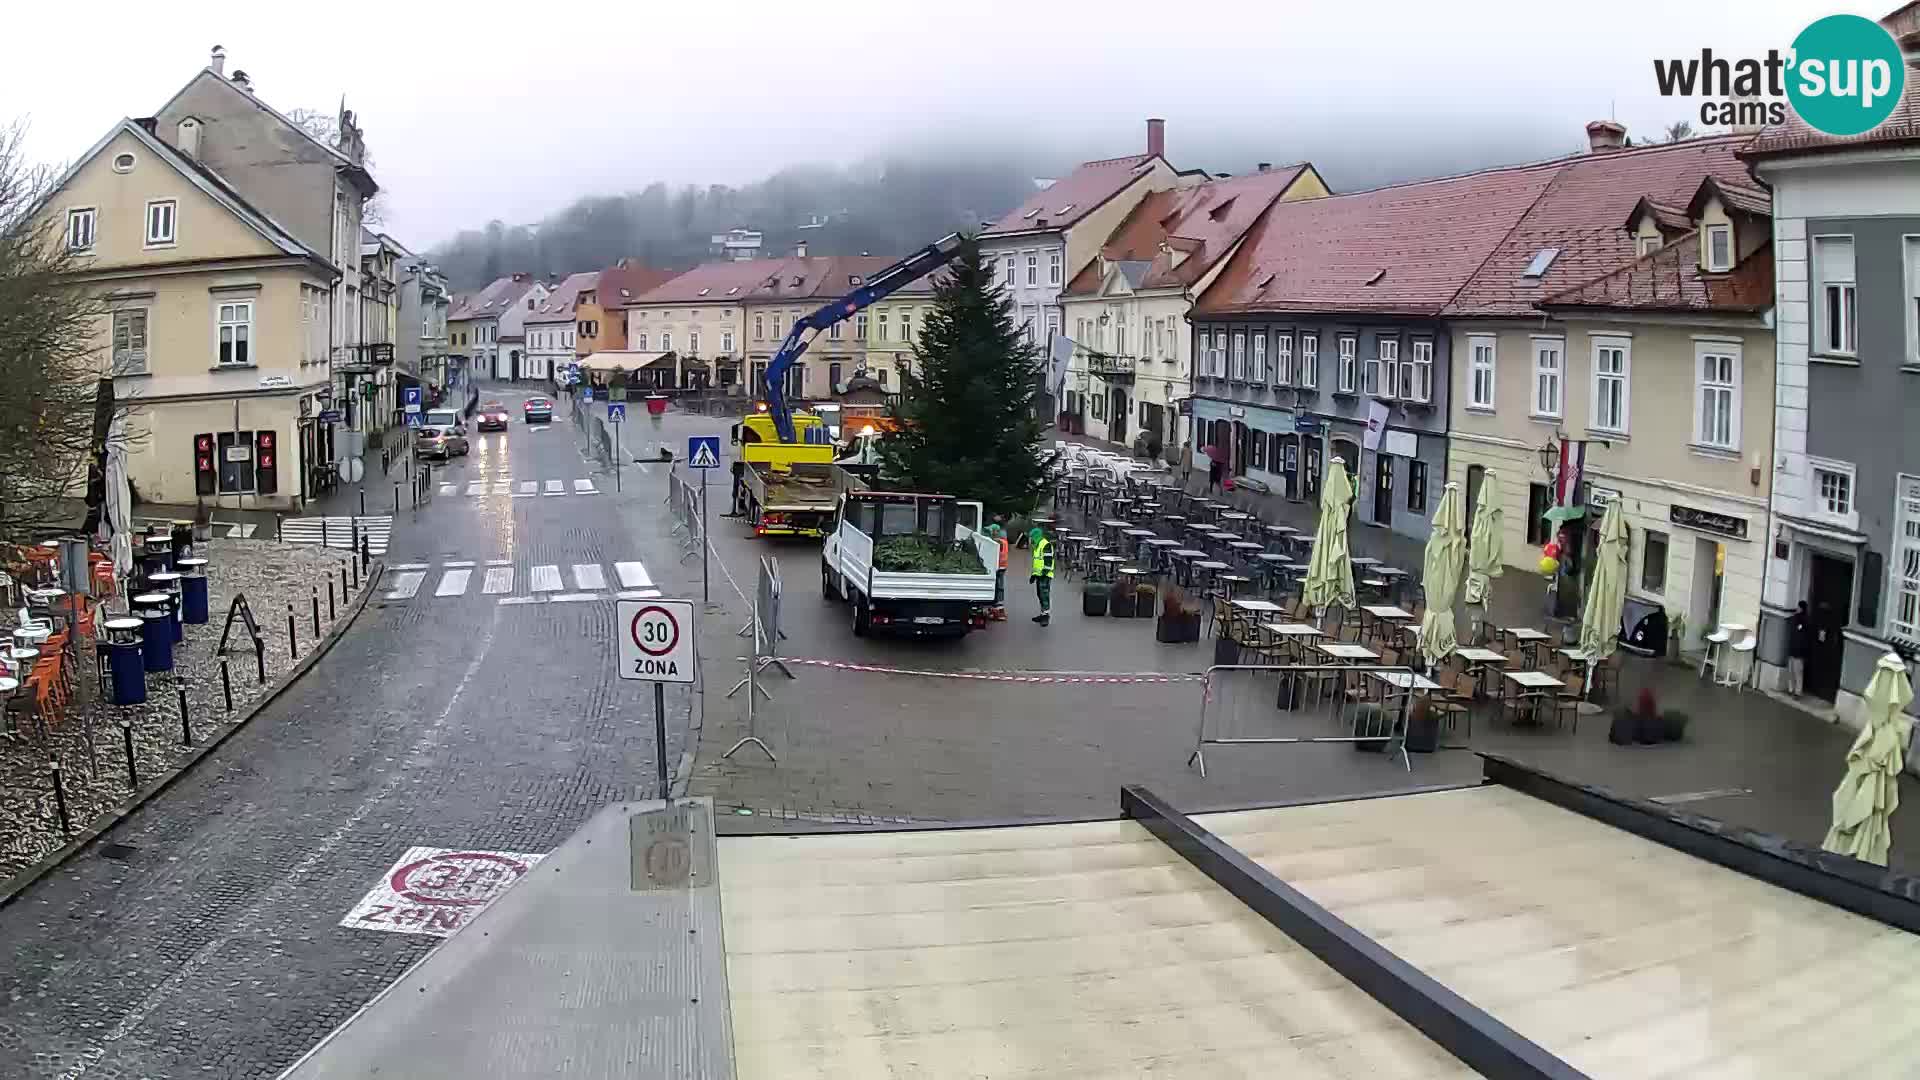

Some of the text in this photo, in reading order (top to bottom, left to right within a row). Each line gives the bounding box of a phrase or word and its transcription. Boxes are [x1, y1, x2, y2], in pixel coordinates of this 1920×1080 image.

[408, 391, 417, 402] P
[643, 621, 668, 643] 30
[634, 658, 679, 676] ZONA
